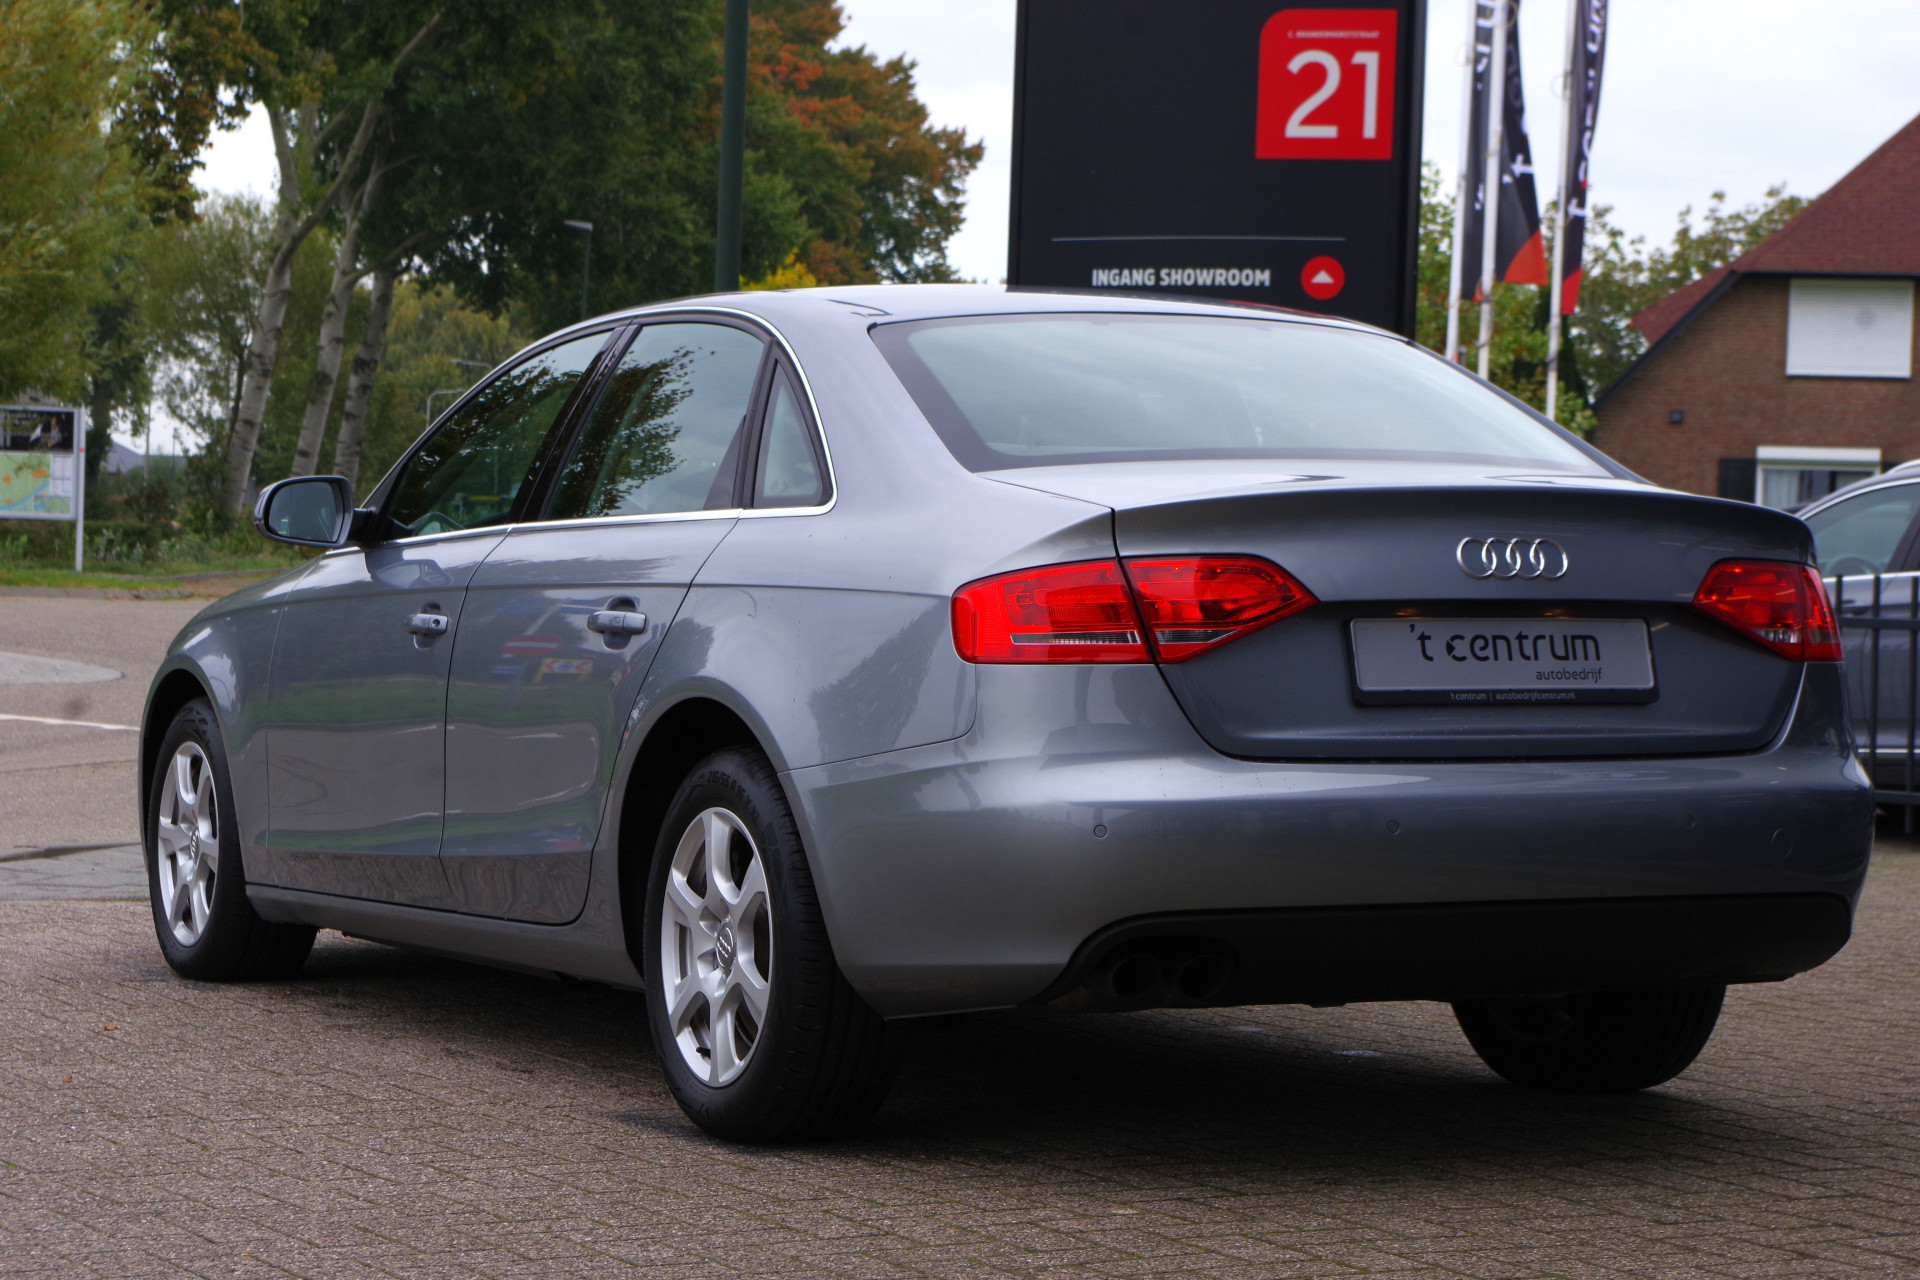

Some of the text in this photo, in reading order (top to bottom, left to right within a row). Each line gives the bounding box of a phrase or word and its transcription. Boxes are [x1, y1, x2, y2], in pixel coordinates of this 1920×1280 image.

[1285, 49, 1380, 139] 21
[1092, 269, 1271, 287] INGANG SHOWROOM
[1446, 631, 1601, 662] centrum
[1535, 668, 1603, 684] autobedrijf
[1456, 692, 1487, 701] centrum
